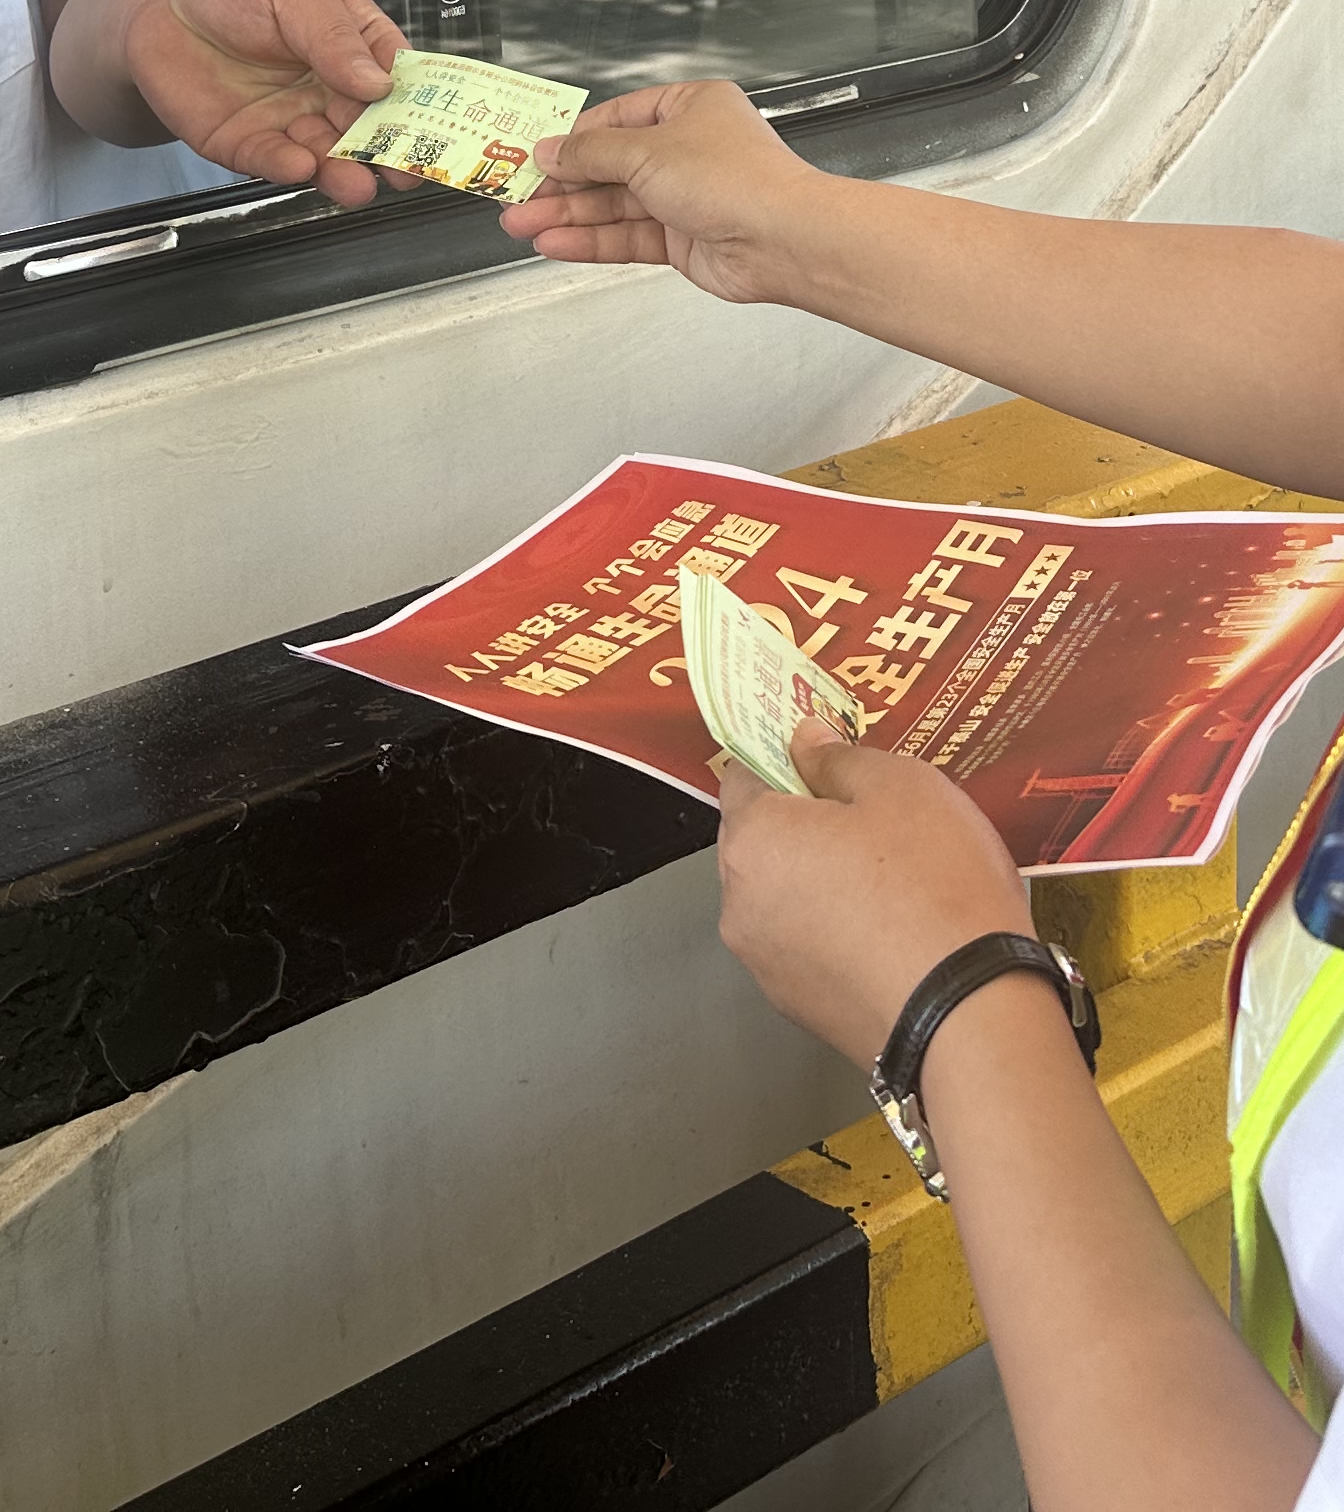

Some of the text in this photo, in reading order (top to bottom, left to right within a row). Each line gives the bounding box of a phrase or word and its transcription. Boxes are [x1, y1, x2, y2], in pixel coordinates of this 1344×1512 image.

[443, 498, 717, 684] 人人讲安全 个个会应急
